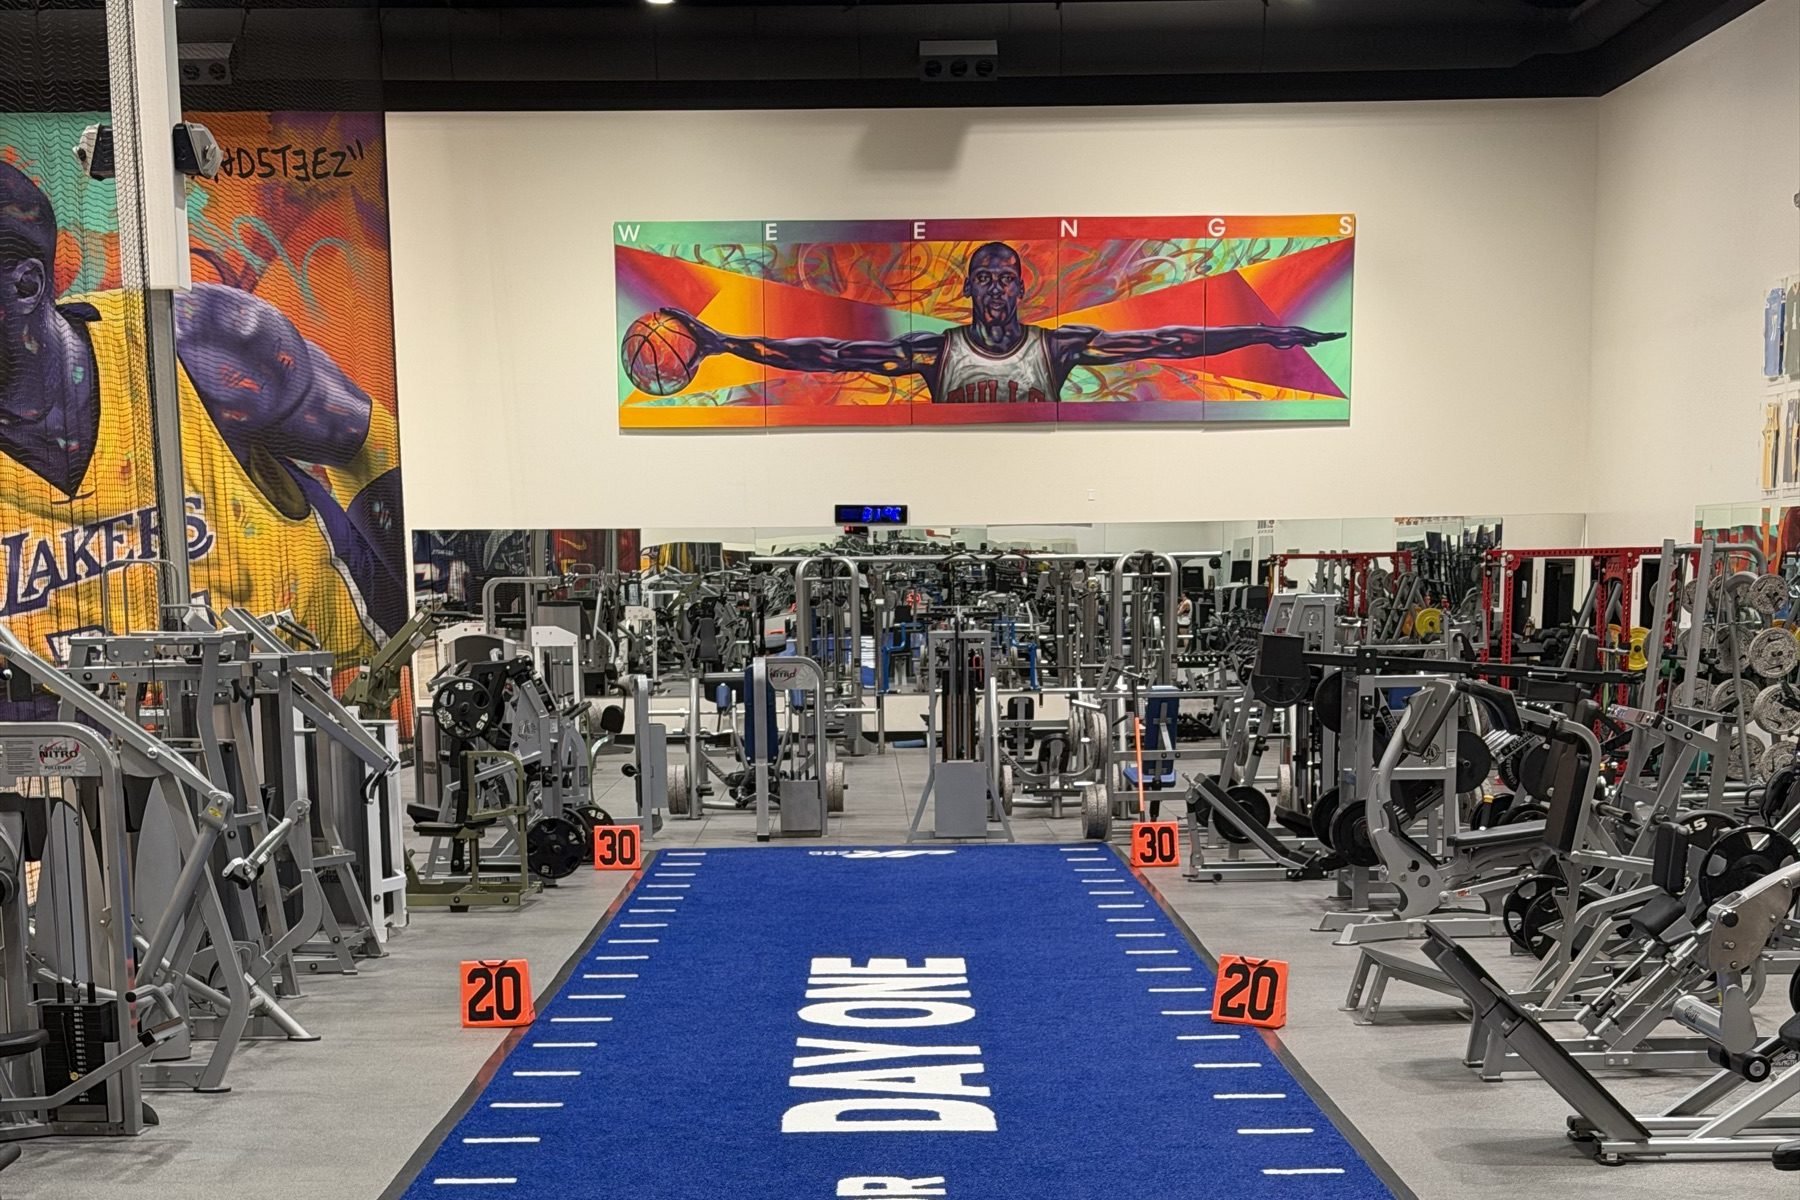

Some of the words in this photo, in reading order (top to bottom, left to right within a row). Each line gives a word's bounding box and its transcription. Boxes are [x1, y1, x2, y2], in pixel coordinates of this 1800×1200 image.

[454, 682, 475, 691] 45
[39, 750, 79, 759] NITRO
[598, 829, 636, 866] 30
[1138, 826, 1176, 863] 30
[467, 966, 522, 1022] 20
[797, 957, 976, 1028] ONE
[1218, 963, 1279, 1021] 20
[781, 1037, 998, 1133] DAY
